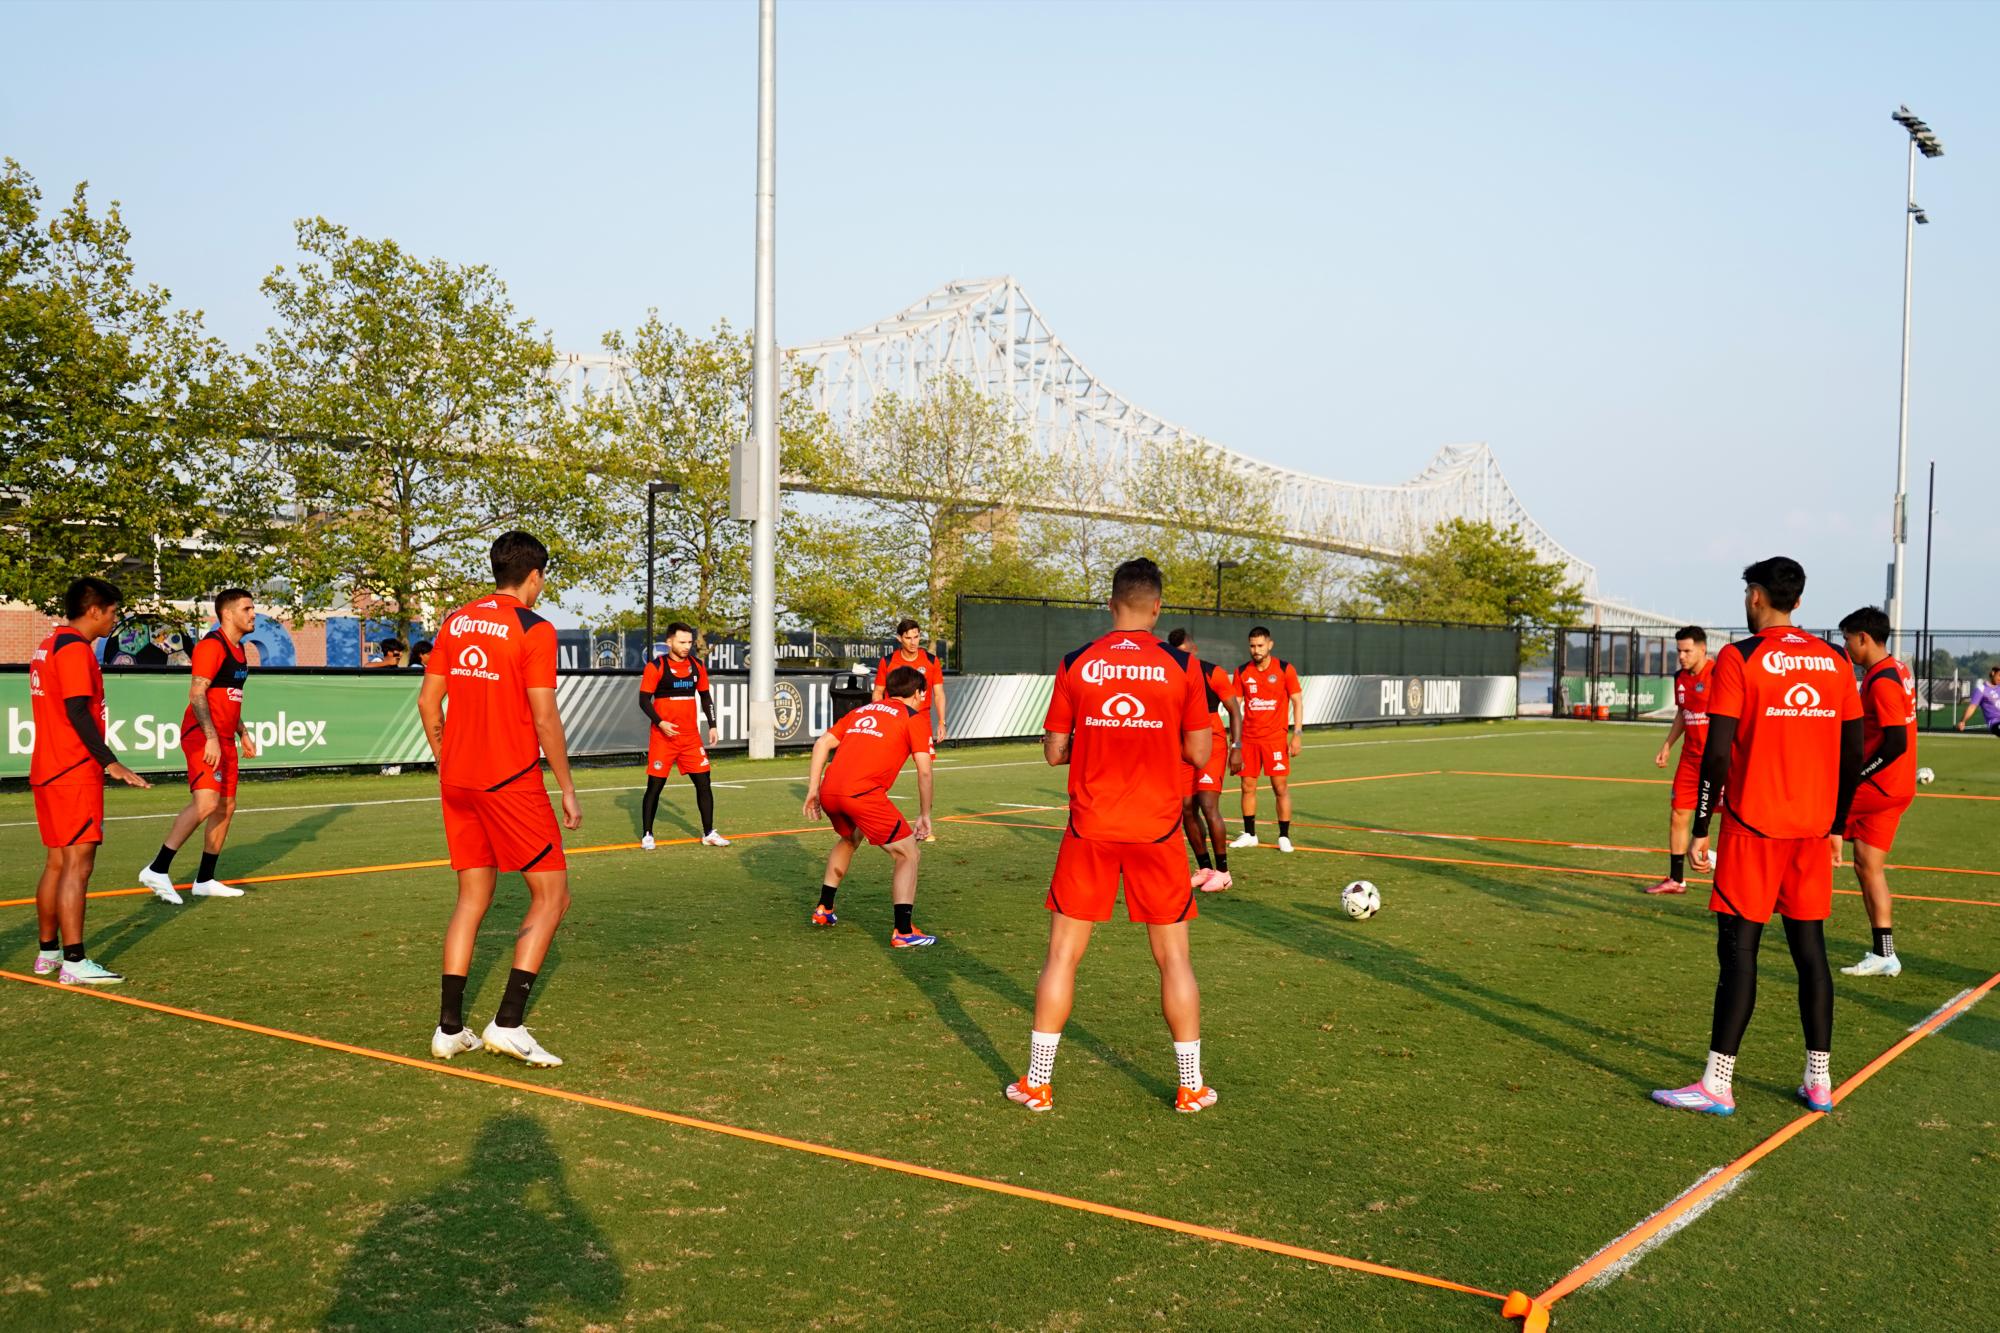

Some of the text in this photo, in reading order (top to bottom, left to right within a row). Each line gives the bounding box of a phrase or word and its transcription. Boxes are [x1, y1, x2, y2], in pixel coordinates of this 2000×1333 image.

[450, 615, 509, 638] Corona
[708, 644, 739, 669] PHL
[844, 644, 880, 659] WELCOME
[450, 668, 472, 676] anco
[1081, 658, 1165, 686] Corona
[1762, 651, 1836, 676] Corona
[1380, 680, 1461, 716] PHL UNION
[1085, 716, 1164, 729] Banco Azteca
[1766, 706, 1836, 718] Banco Azteca
[1861, 757, 1883, 776] PIRMA
[1699, 780, 1711, 818] PIRMA
